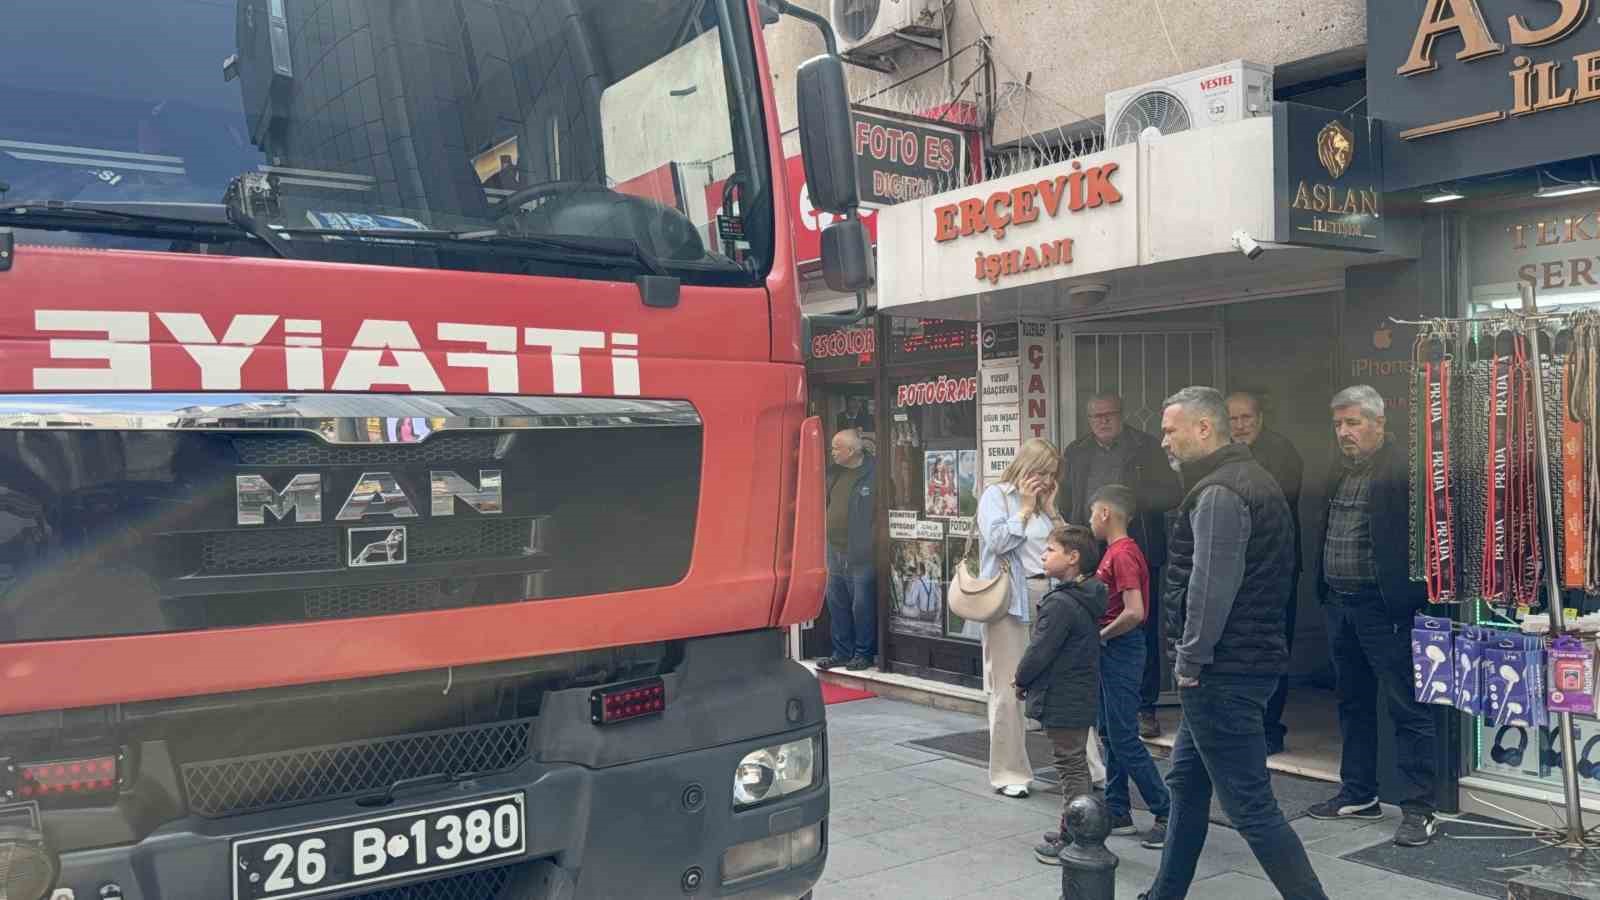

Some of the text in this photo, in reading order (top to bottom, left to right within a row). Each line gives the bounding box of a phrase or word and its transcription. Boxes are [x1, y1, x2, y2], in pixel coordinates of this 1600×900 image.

[1200, 75, 1233, 91] VESTEL
[855, 121, 955, 172] FOTO ES
[934, 161, 1123, 242] ERÇEVİK
[1292, 180, 1378, 216] ASLAN
[1511, 210, 1600, 250] TEK
[975, 238, 1074, 284] İŞHANI
[1517, 256, 1600, 291] SER
[897, 376, 977, 408] FOTOĞRAF
[1430, 383, 1442, 423] PRADA
[1496, 374, 1509, 417] PRADA
[988, 447, 1015, 457] SERKAN
[1432, 451, 1445, 491] PRADA
[1495, 447, 1506, 489] PRADA
[236, 470, 503, 525] MAN
[1436, 520, 1450, 561] PRADA
[1495, 518, 1505, 560] PRADA
[263, 804, 519, 892] 26 B 1380
